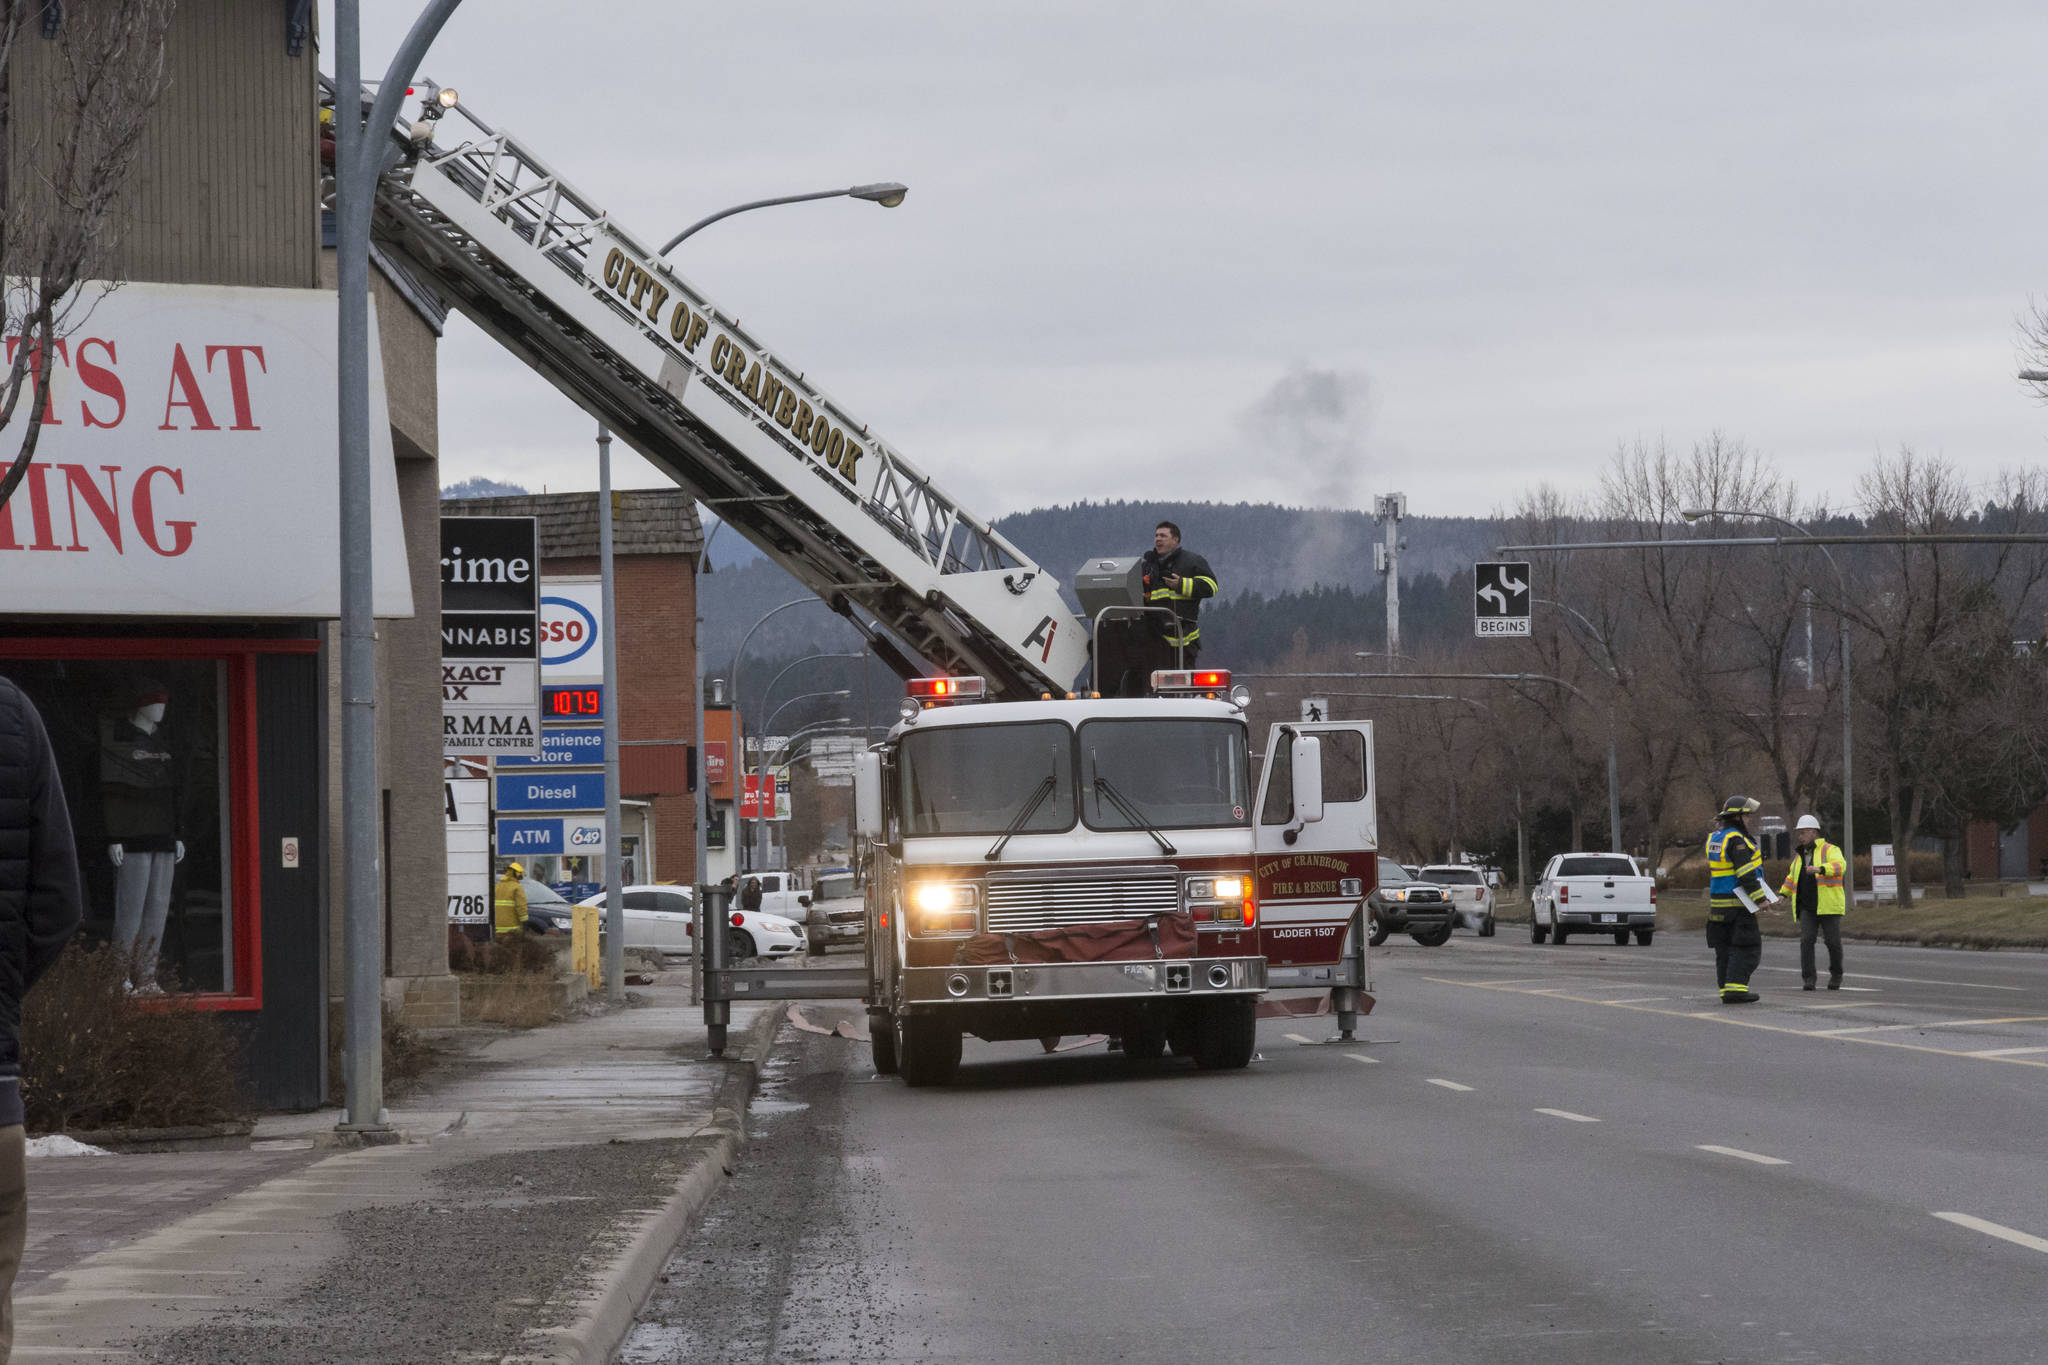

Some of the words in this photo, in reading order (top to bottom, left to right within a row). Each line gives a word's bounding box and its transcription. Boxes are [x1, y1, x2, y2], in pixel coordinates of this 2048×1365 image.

[603, 247, 670, 325] CITY
[670, 301, 709, 354] OF
[710, 333, 864, 486] CRANBROOK
[0, 336, 127, 430] TS
[157, 342, 267, 431] AT
[1480, 621, 1526, 632] BEGINS
[442, 666, 506, 681] XACT
[553, 690, 600, 714] 107.9
[444, 716, 534, 736] RMMA
[444, 737, 485, 747] FAMILY
[487, 737, 535, 748] CENTRE
[541, 733, 602, 746] enience
[530, 751, 573, 763] Store
[527, 785, 577, 800] Diesel
[511, 830, 550, 844] ATM
[1259, 860, 1281, 878] CITY
[1281, 857, 1293, 869] OF
[1294, 855, 1350, 874] CRANBROOK
[1272, 883, 1294, 895] FIRE
[1303, 881, 1337, 894] RESCUE
[1273, 928, 1312, 939] LADDER
[1314, 927, 1336, 937] 1507
